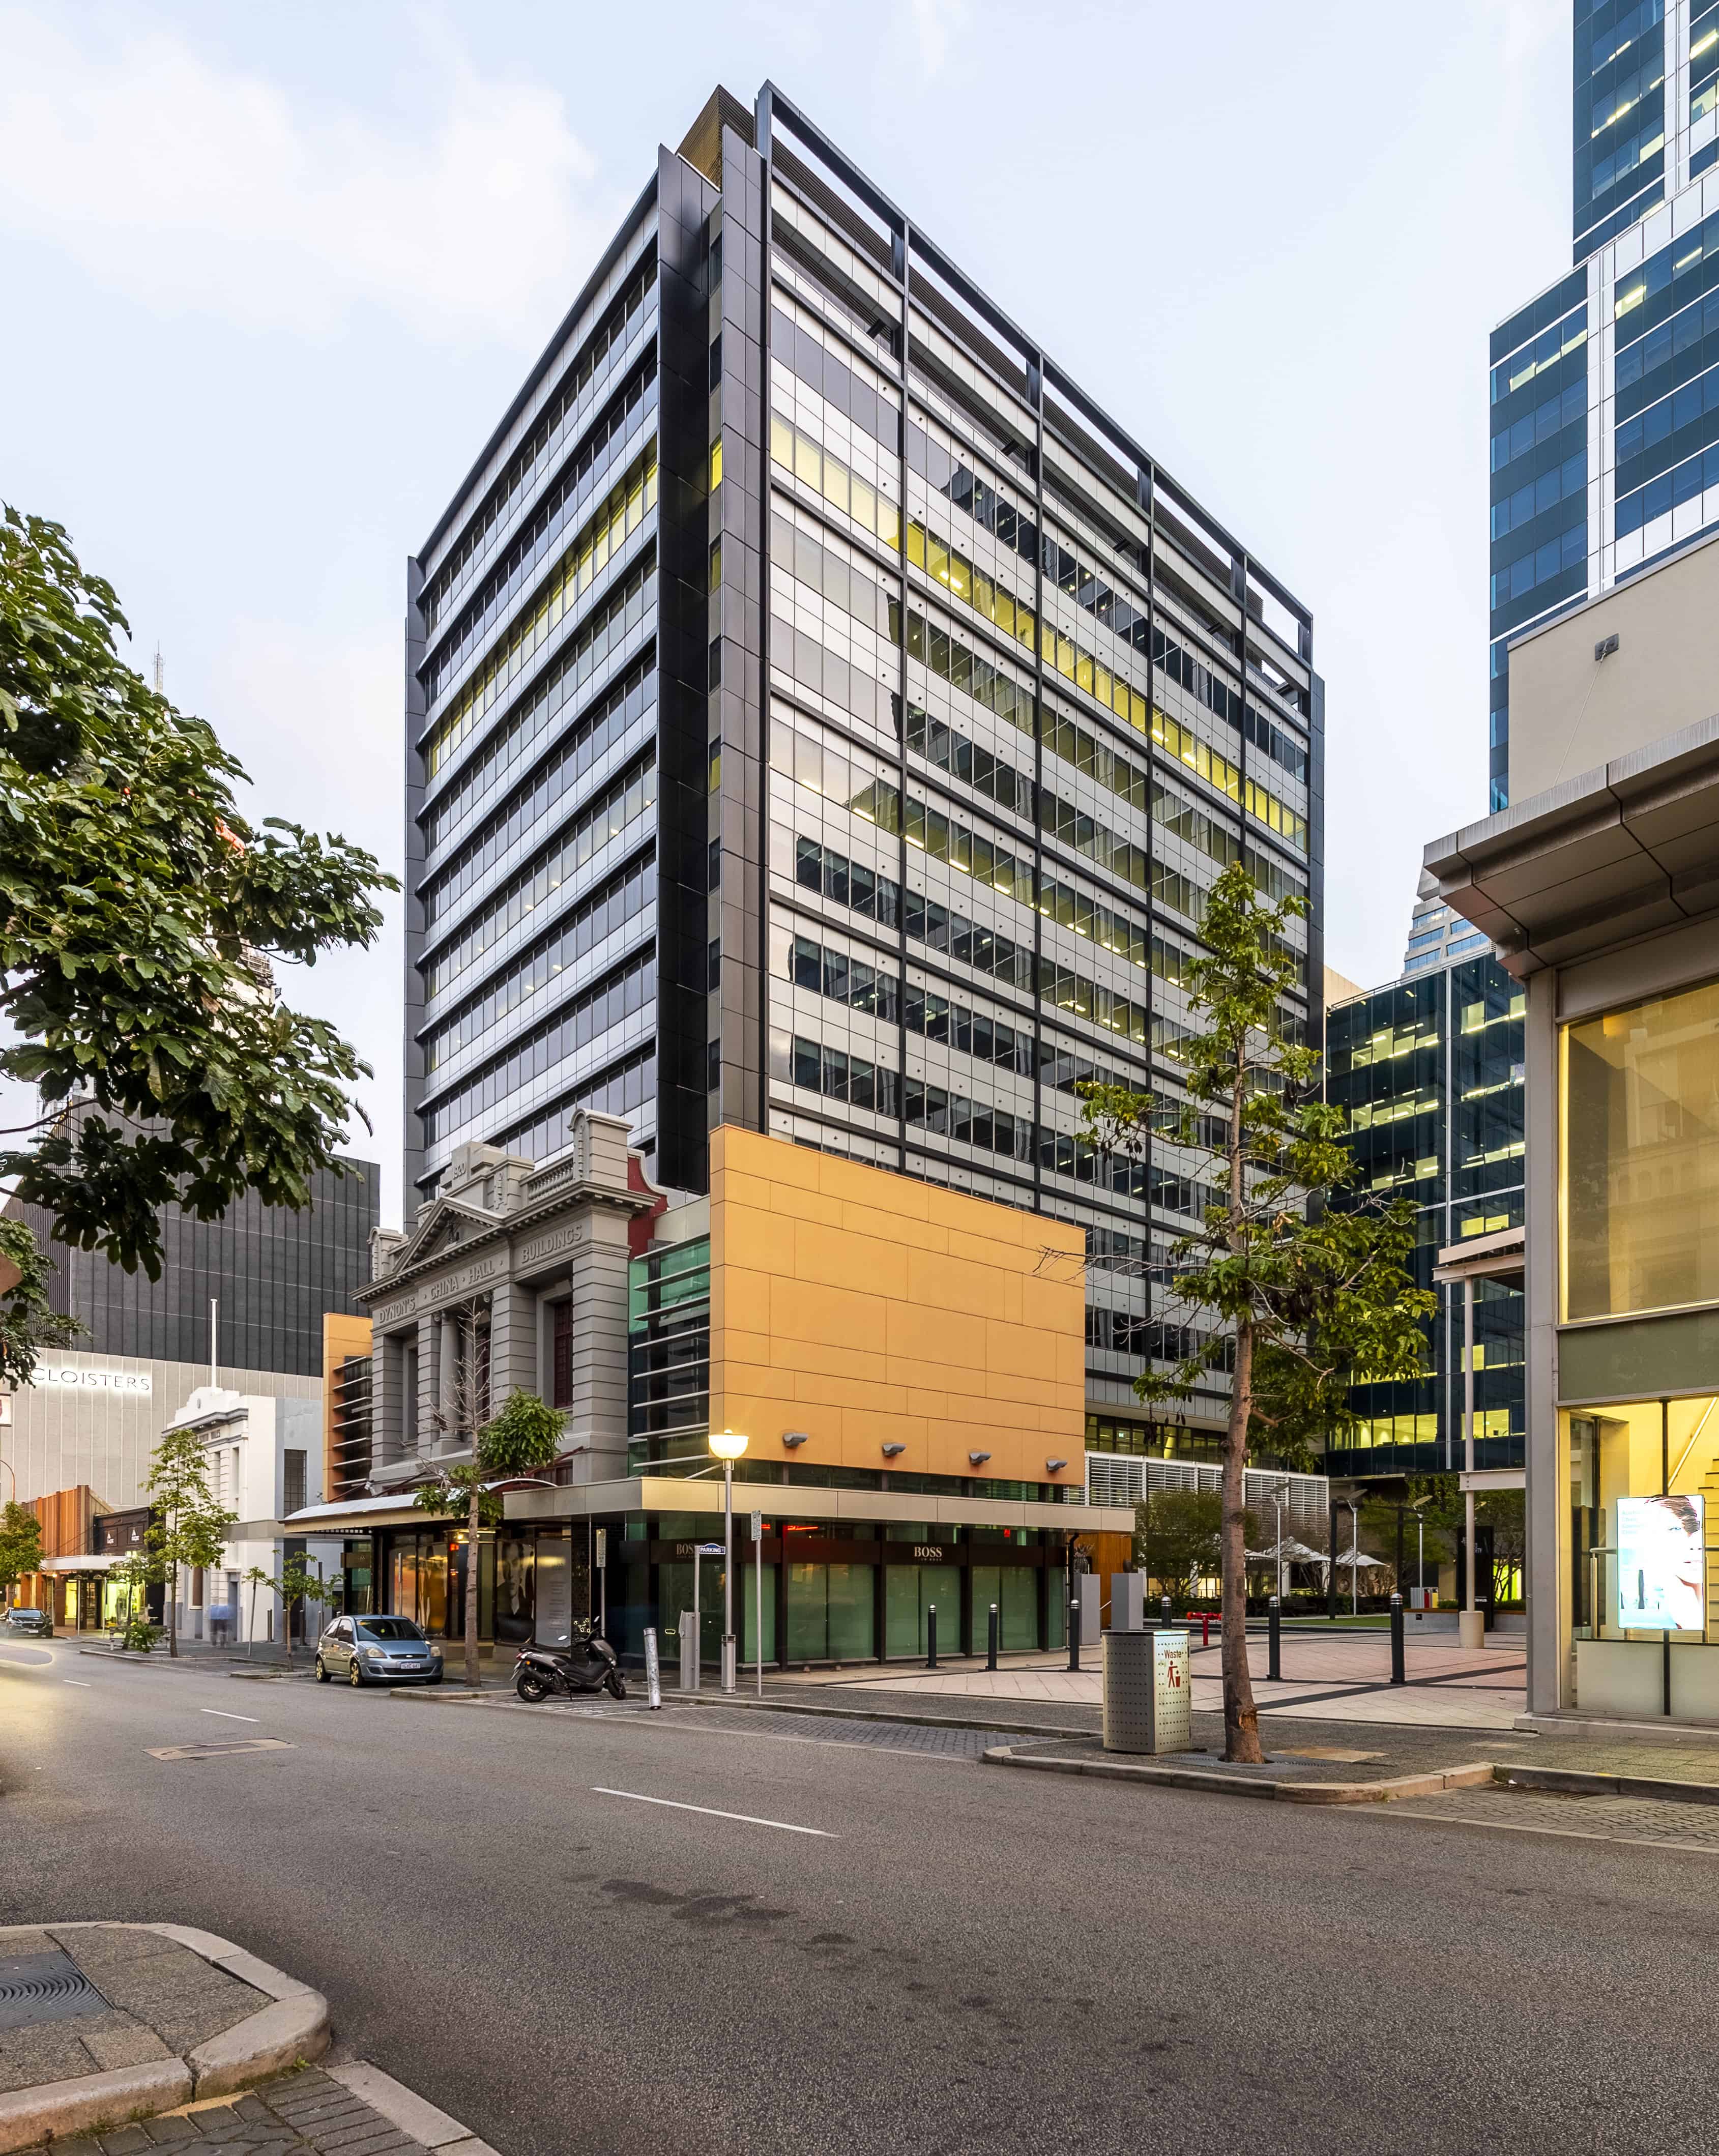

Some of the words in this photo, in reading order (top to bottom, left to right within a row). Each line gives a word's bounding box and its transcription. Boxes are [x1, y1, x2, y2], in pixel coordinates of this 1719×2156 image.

[380, 1297, 416, 1323] DYNON'S
[431, 1276, 459, 1300] CHINA
[469, 1260, 495, 1285] HALL
[521, 1225, 582, 1264] BUILDINGS
[30, 1367, 150, 1390] CLOISTERS
[914, 1547, 942, 1558] BOSS
[1164, 1649, 1182, 1659] Waste
